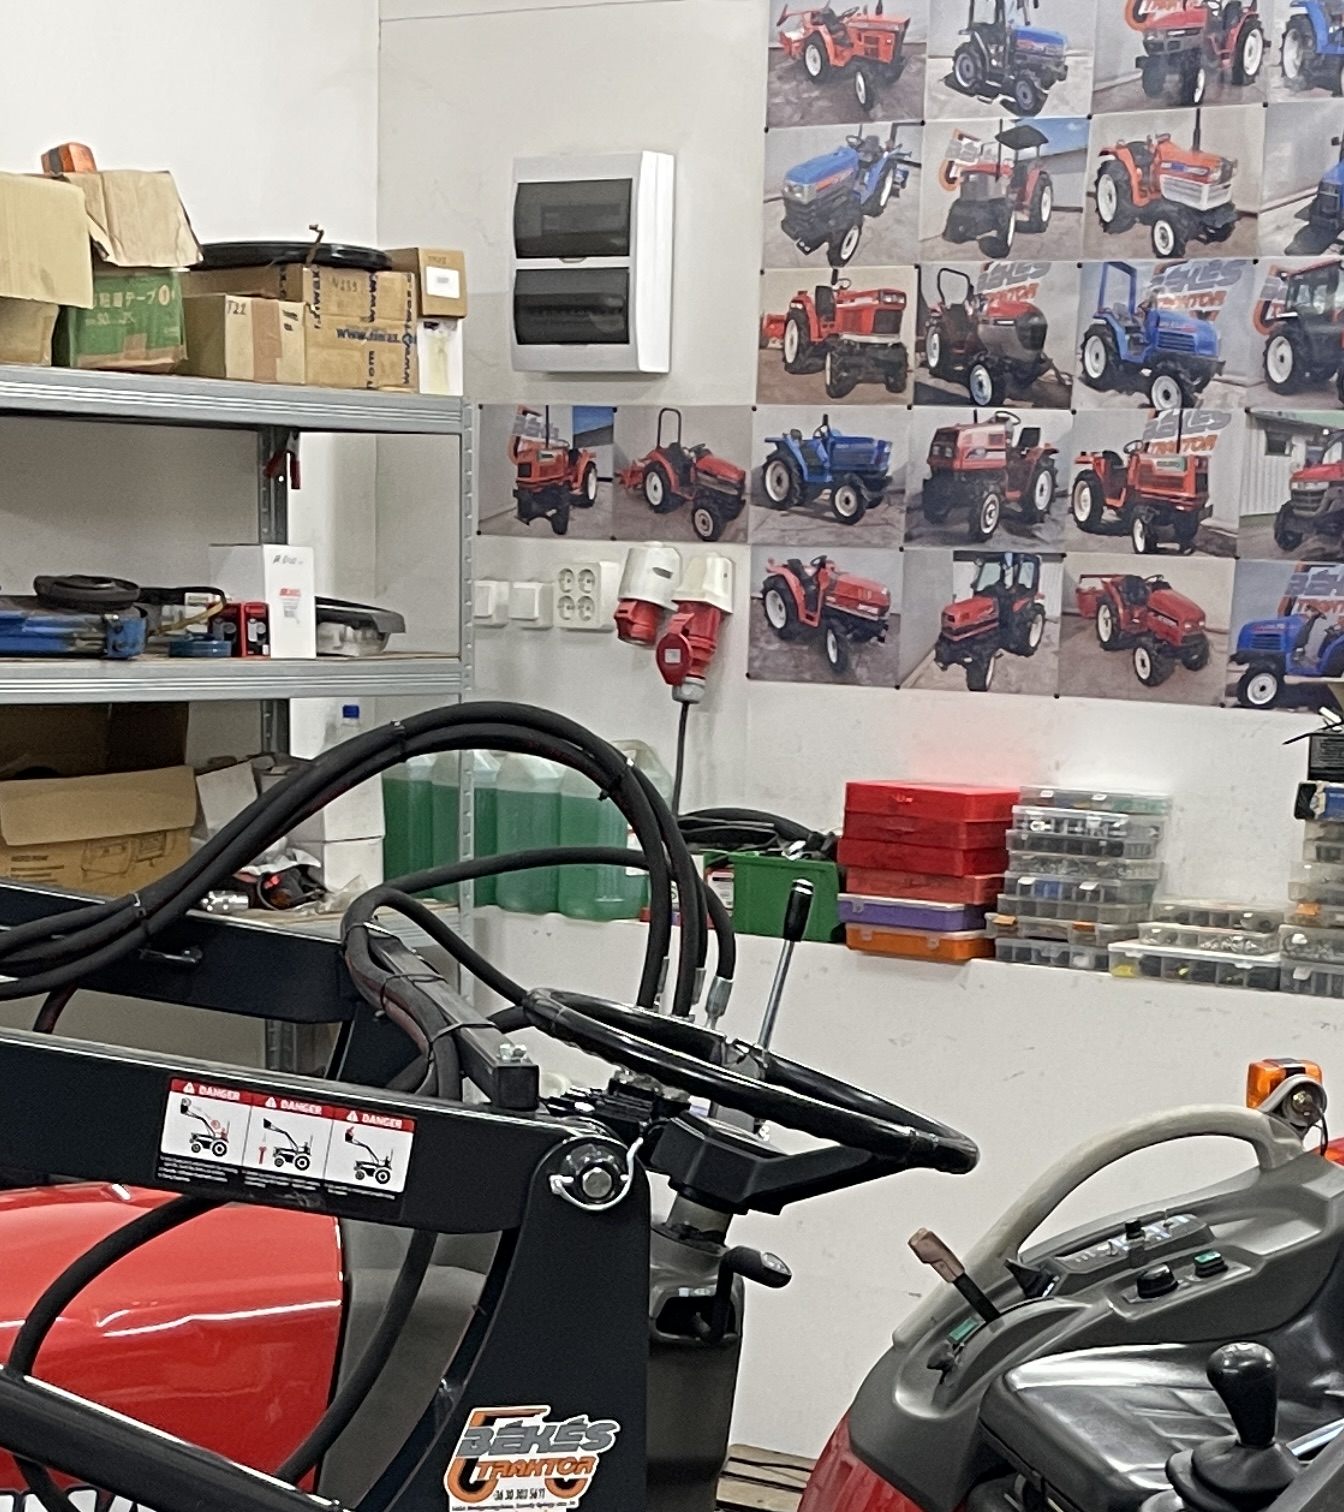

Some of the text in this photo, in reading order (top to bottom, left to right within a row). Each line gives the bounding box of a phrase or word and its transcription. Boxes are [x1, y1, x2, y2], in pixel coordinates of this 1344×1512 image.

[198, 1085, 241, 1101] DANGER
[280, 1099, 322, 1115] DANGER
[361, 1113, 403, 1129] DANGER
[457, 1418, 618, 1457] BÉKÉS
[476, 1456, 597, 1482] TRAKTOR
